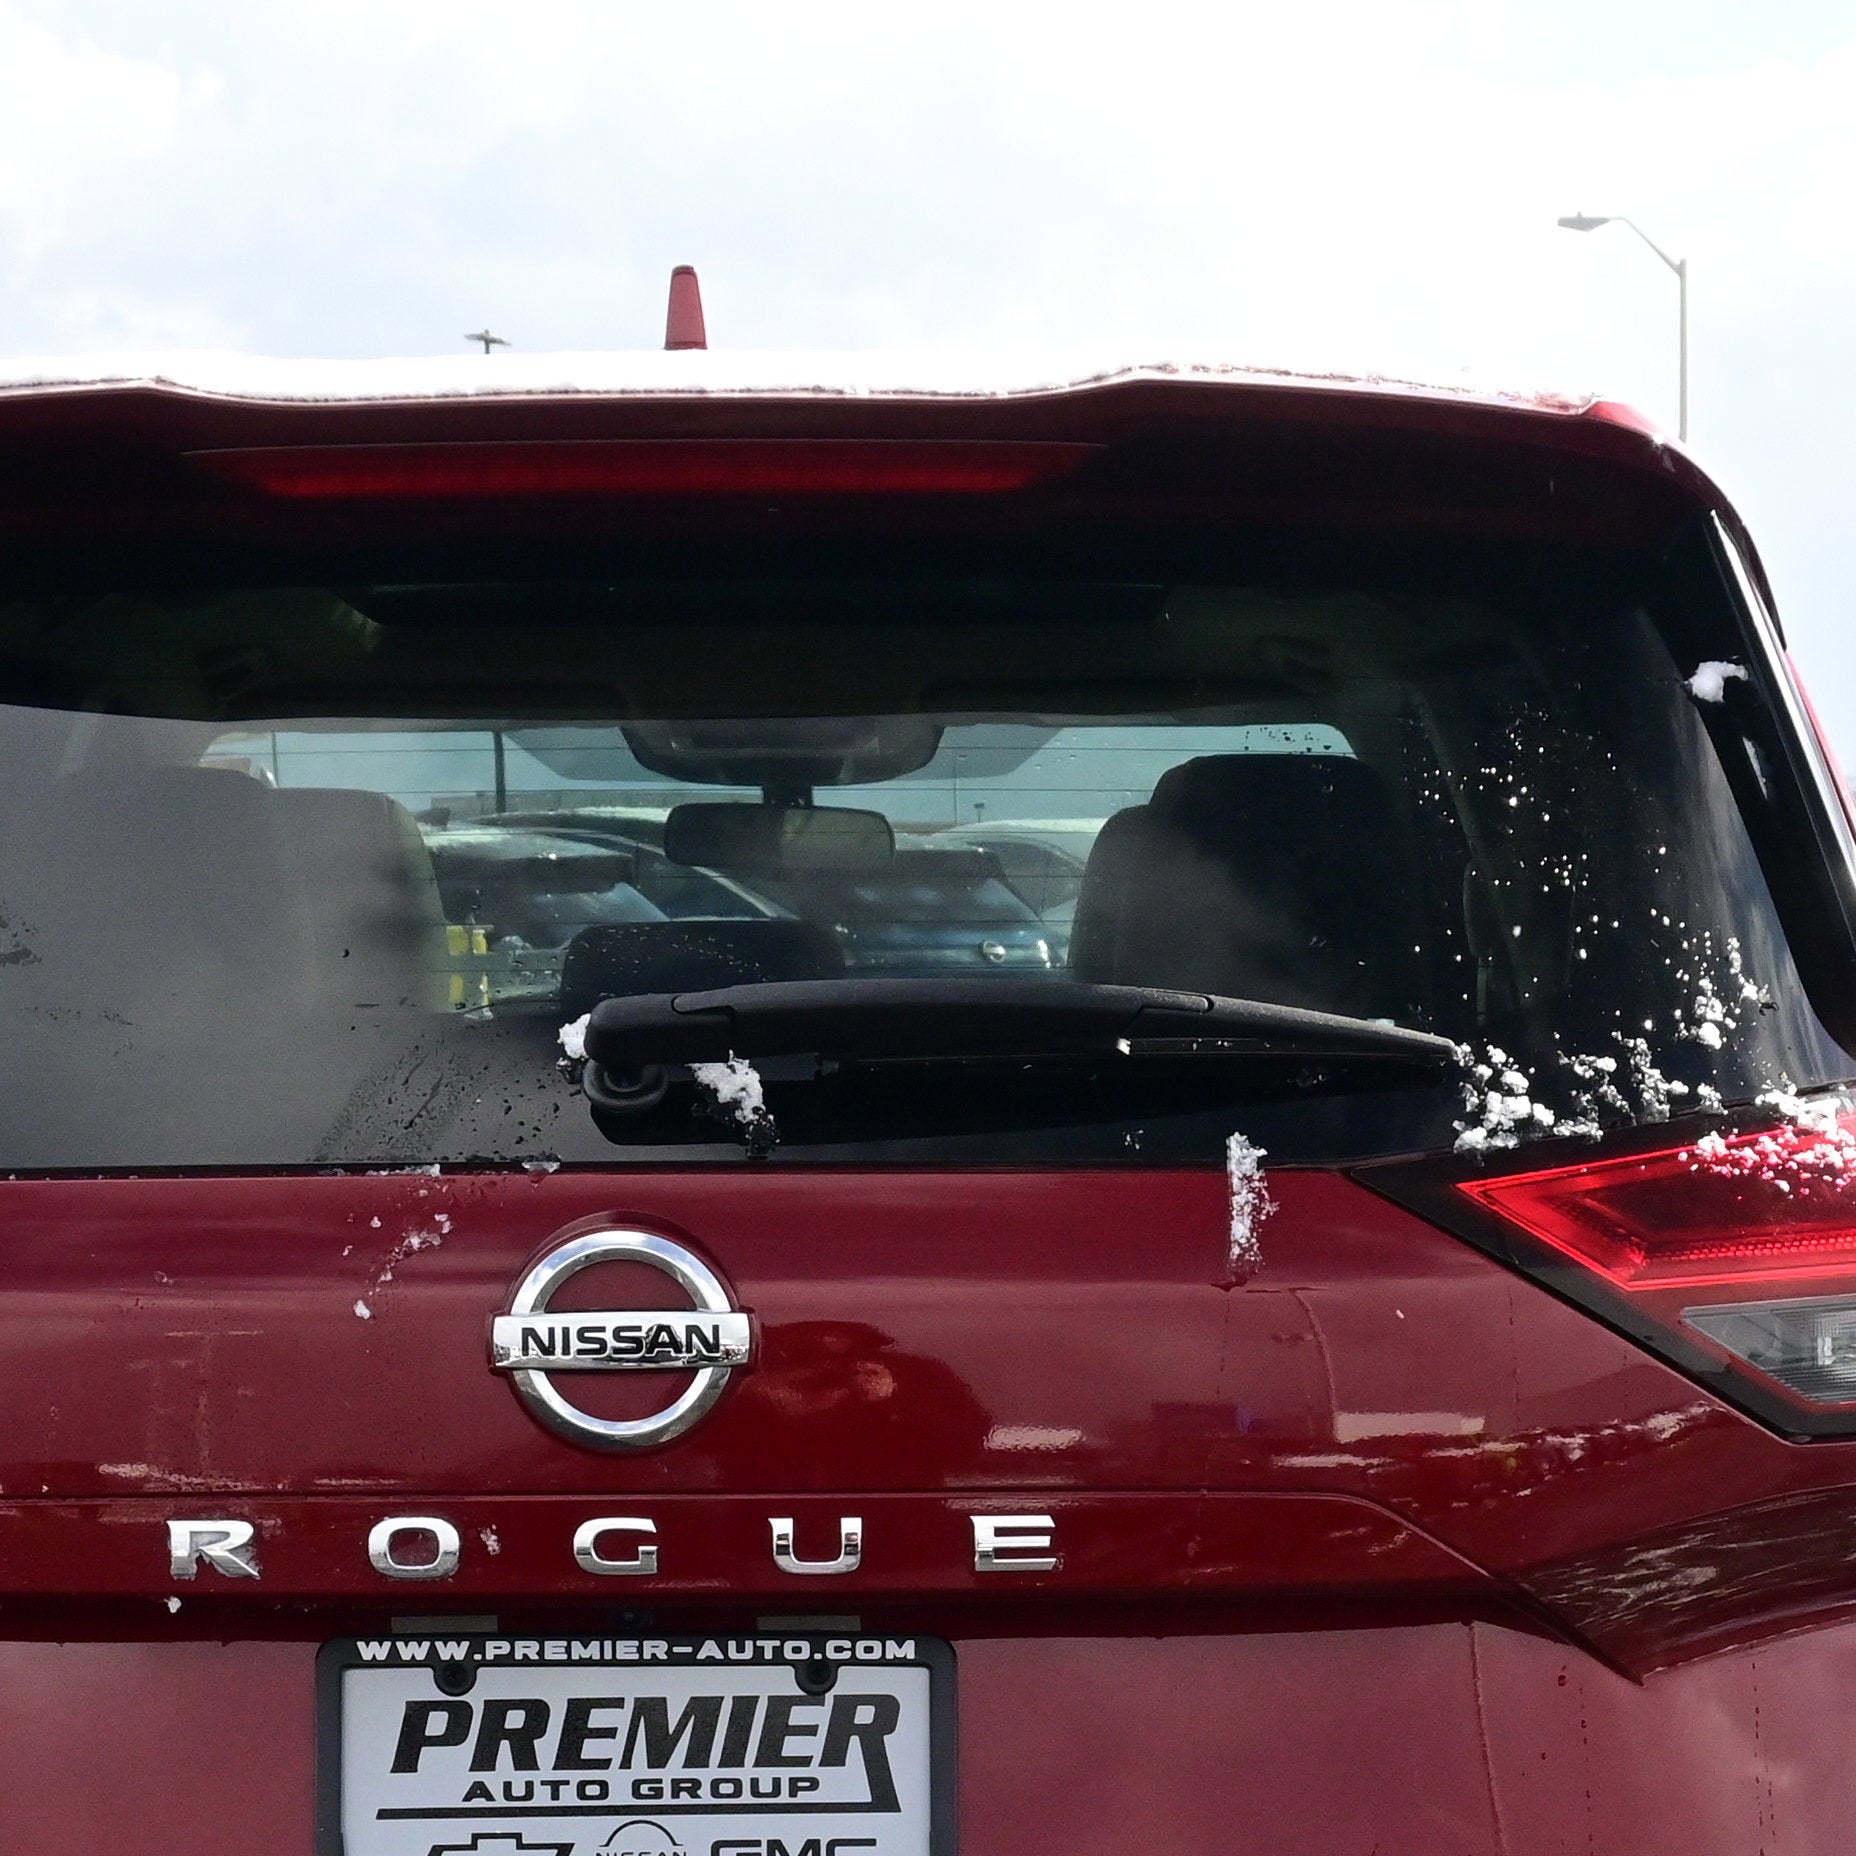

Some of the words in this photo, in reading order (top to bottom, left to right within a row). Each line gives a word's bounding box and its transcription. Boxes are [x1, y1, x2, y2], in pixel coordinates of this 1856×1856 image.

[520, 1323, 721, 1357] NISSAN
[166, 1513, 1058, 1580] ROGUE
[355, 1639, 917, 1662] WWW.PREMIER-AUTO.COM
[389, 1693, 902, 1812] PREMIER
[461, 1777, 611, 1802] AUTO
[630, 1775, 821, 1801] GROUP
